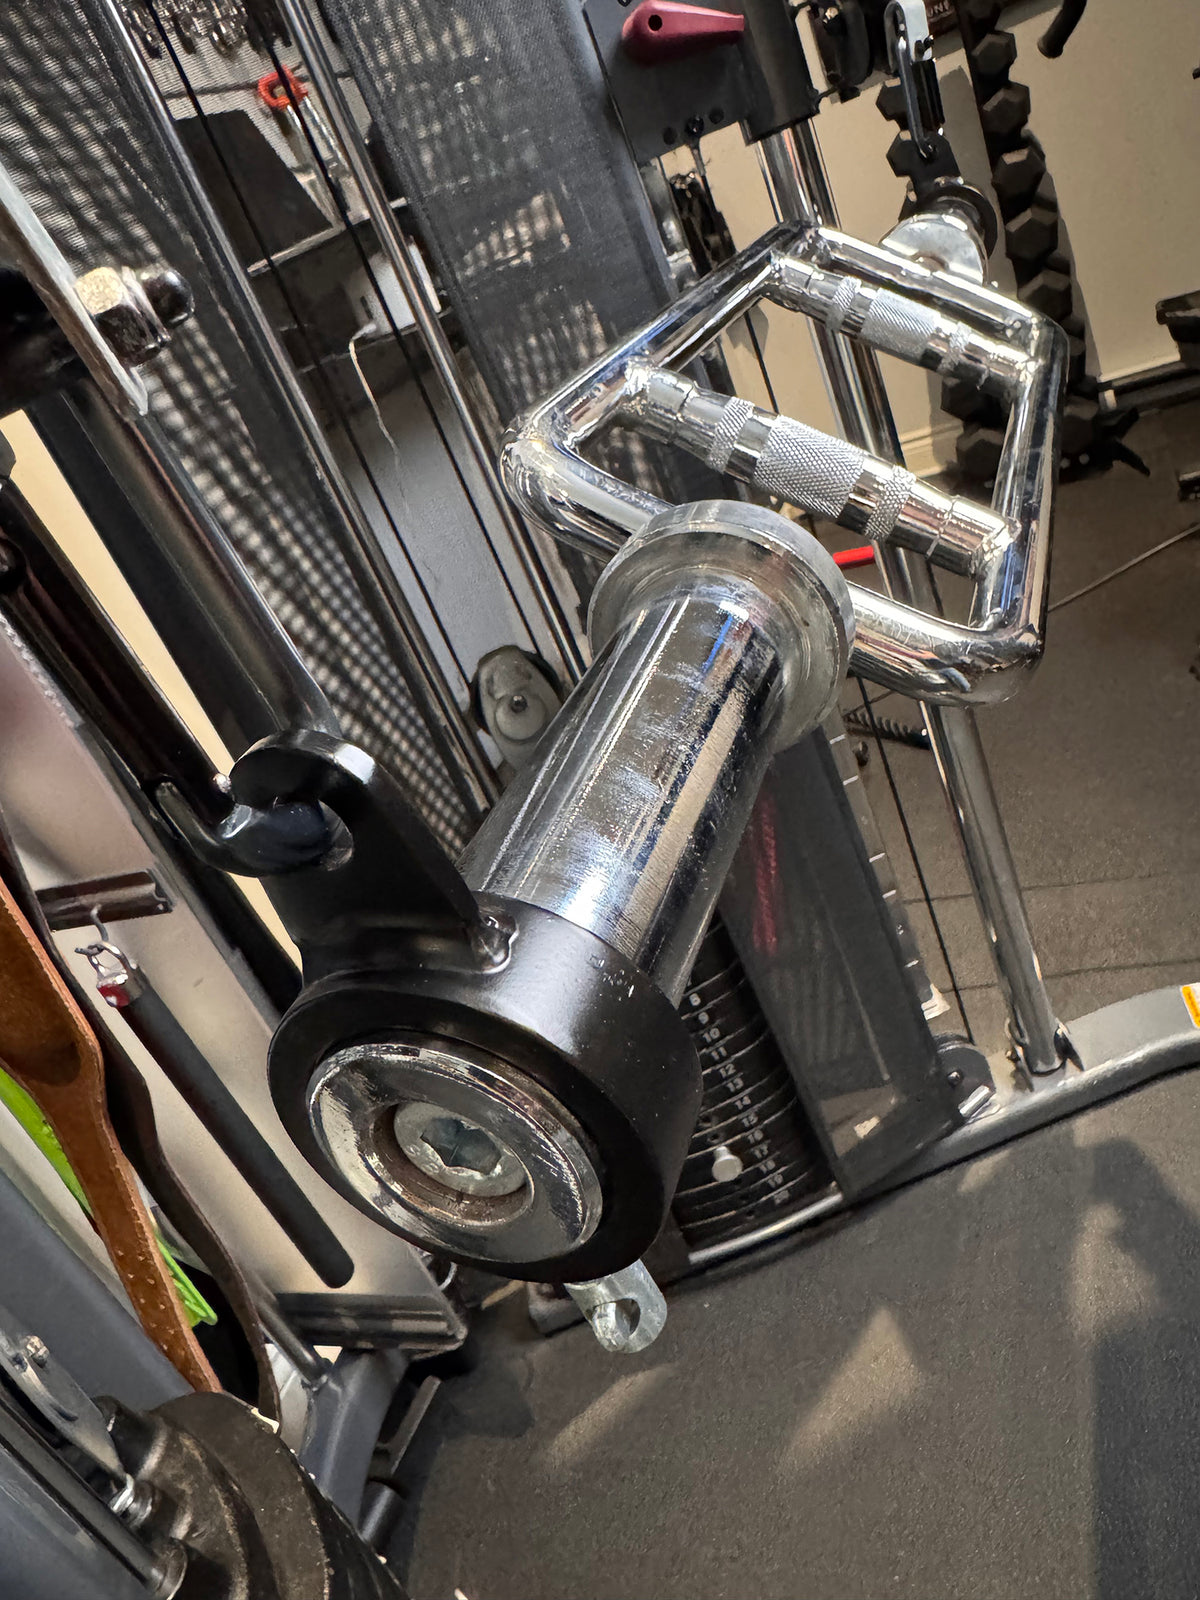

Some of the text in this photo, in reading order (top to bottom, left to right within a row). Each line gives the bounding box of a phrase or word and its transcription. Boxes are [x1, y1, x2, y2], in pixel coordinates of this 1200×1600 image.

[703, 1027, 720, 1043] 10
[711, 1046, 728, 1060] 11
[720, 1063, 737, 1078] 12
[727, 1077, 744, 1092] 13
[735, 1095, 751, 1110] 14
